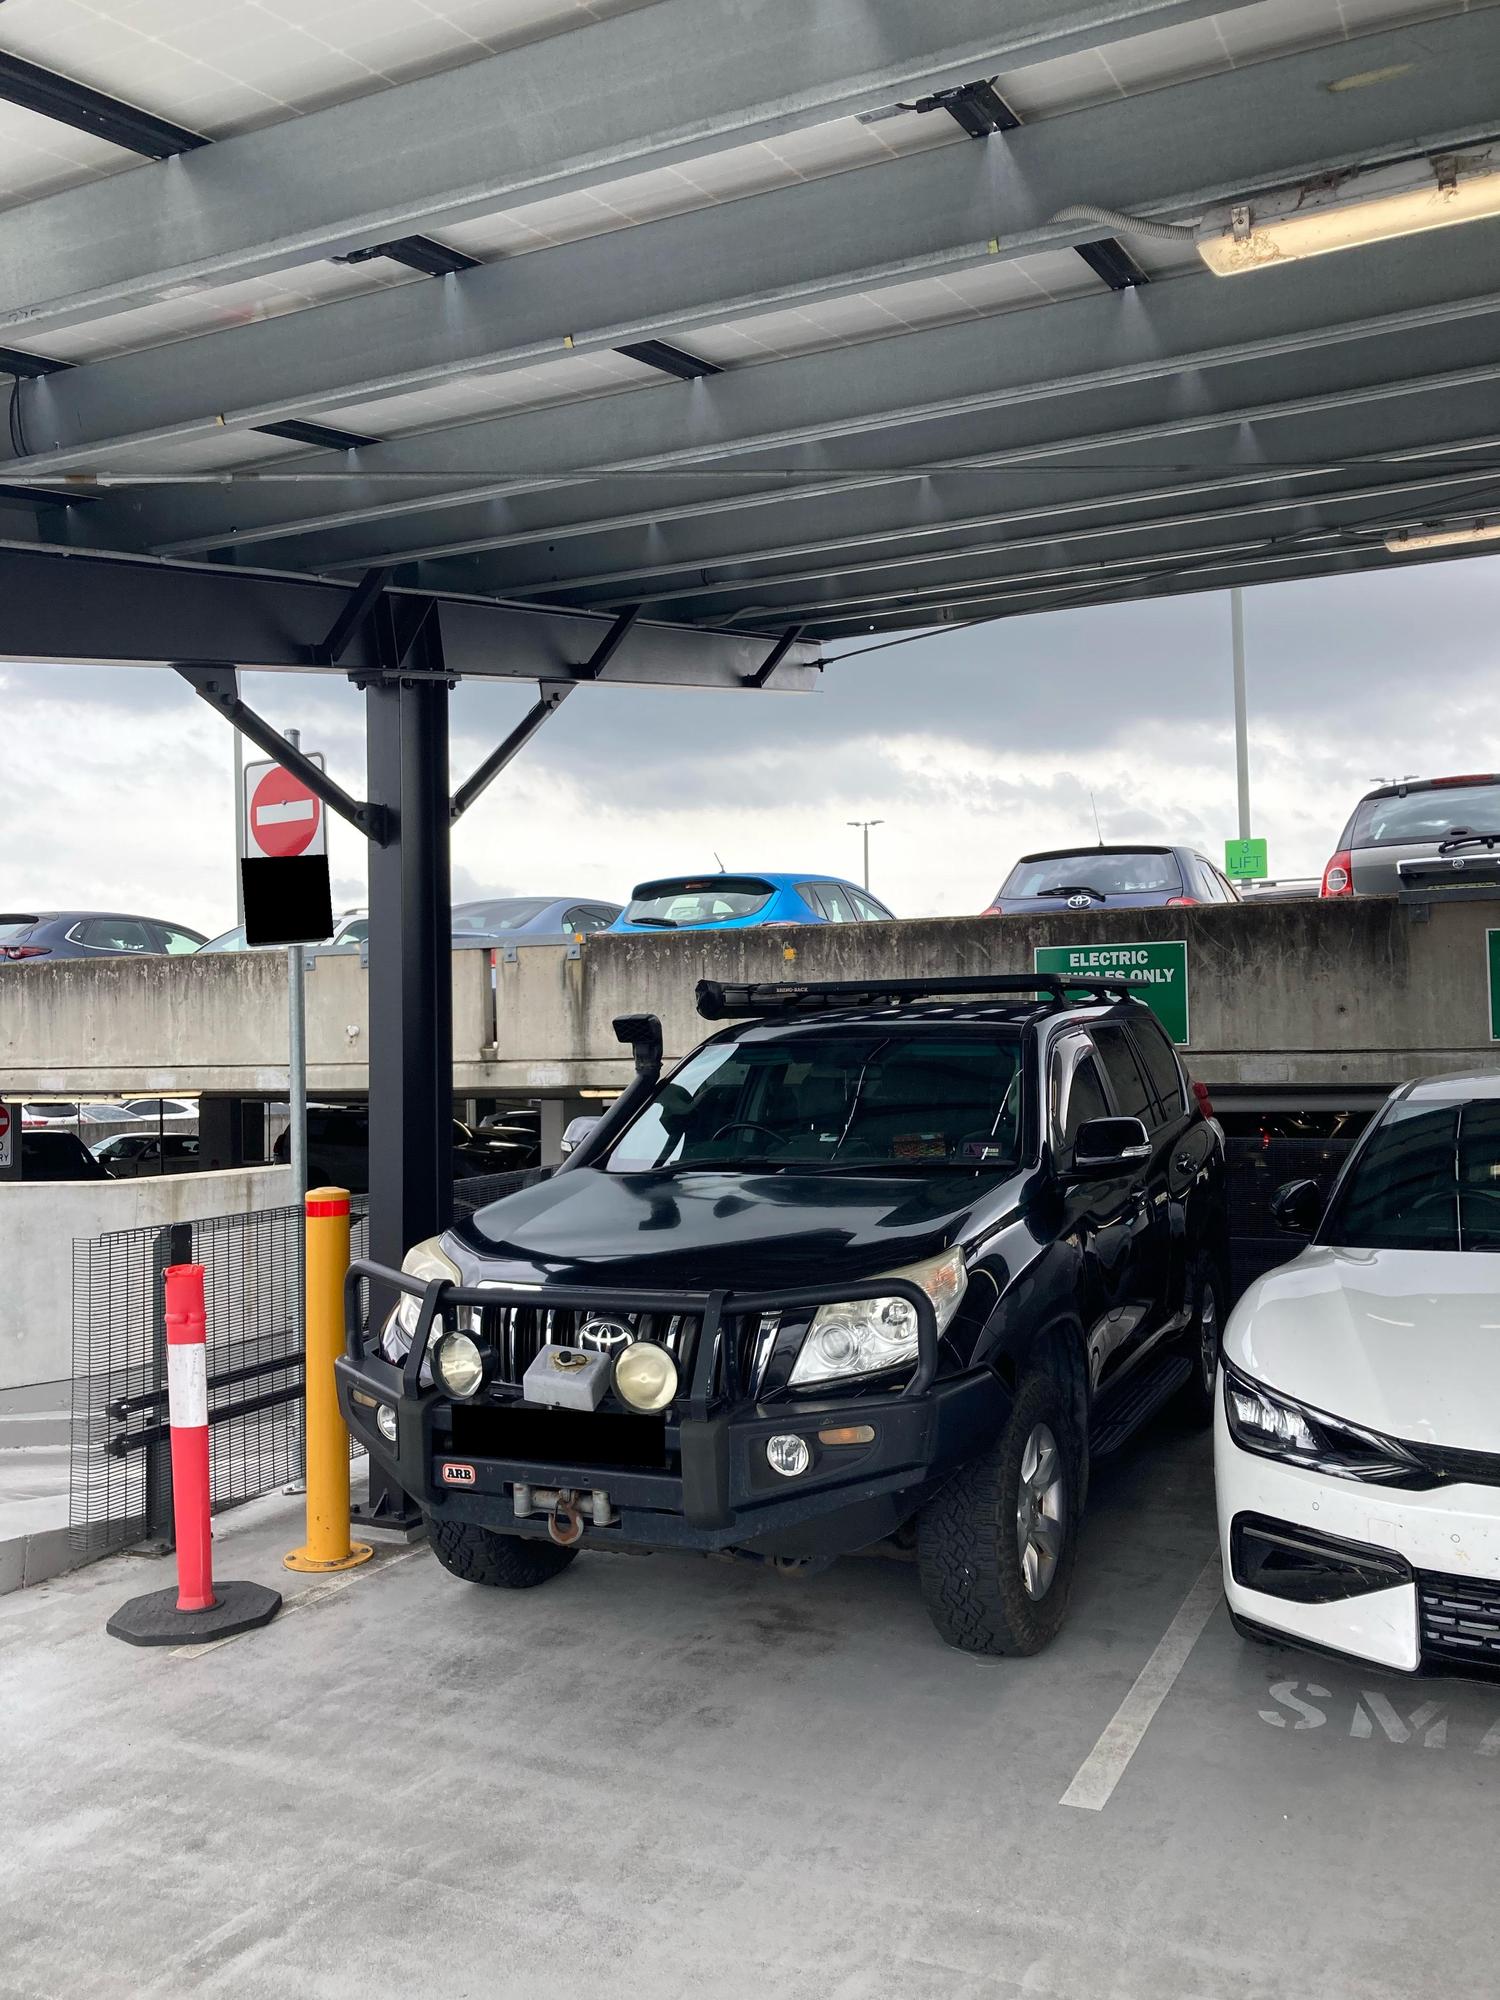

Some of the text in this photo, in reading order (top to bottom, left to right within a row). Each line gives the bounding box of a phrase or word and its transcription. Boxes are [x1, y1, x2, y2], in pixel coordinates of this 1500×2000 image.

[1241, 841, 1249, 854] 3
[1230, 855, 1262, 869] LIFT
[1069, 950, 1149, 967] ELECTRIC
[1130, 968, 1175, 983] ONLY
[447, 1468, 472, 1480] ARB
